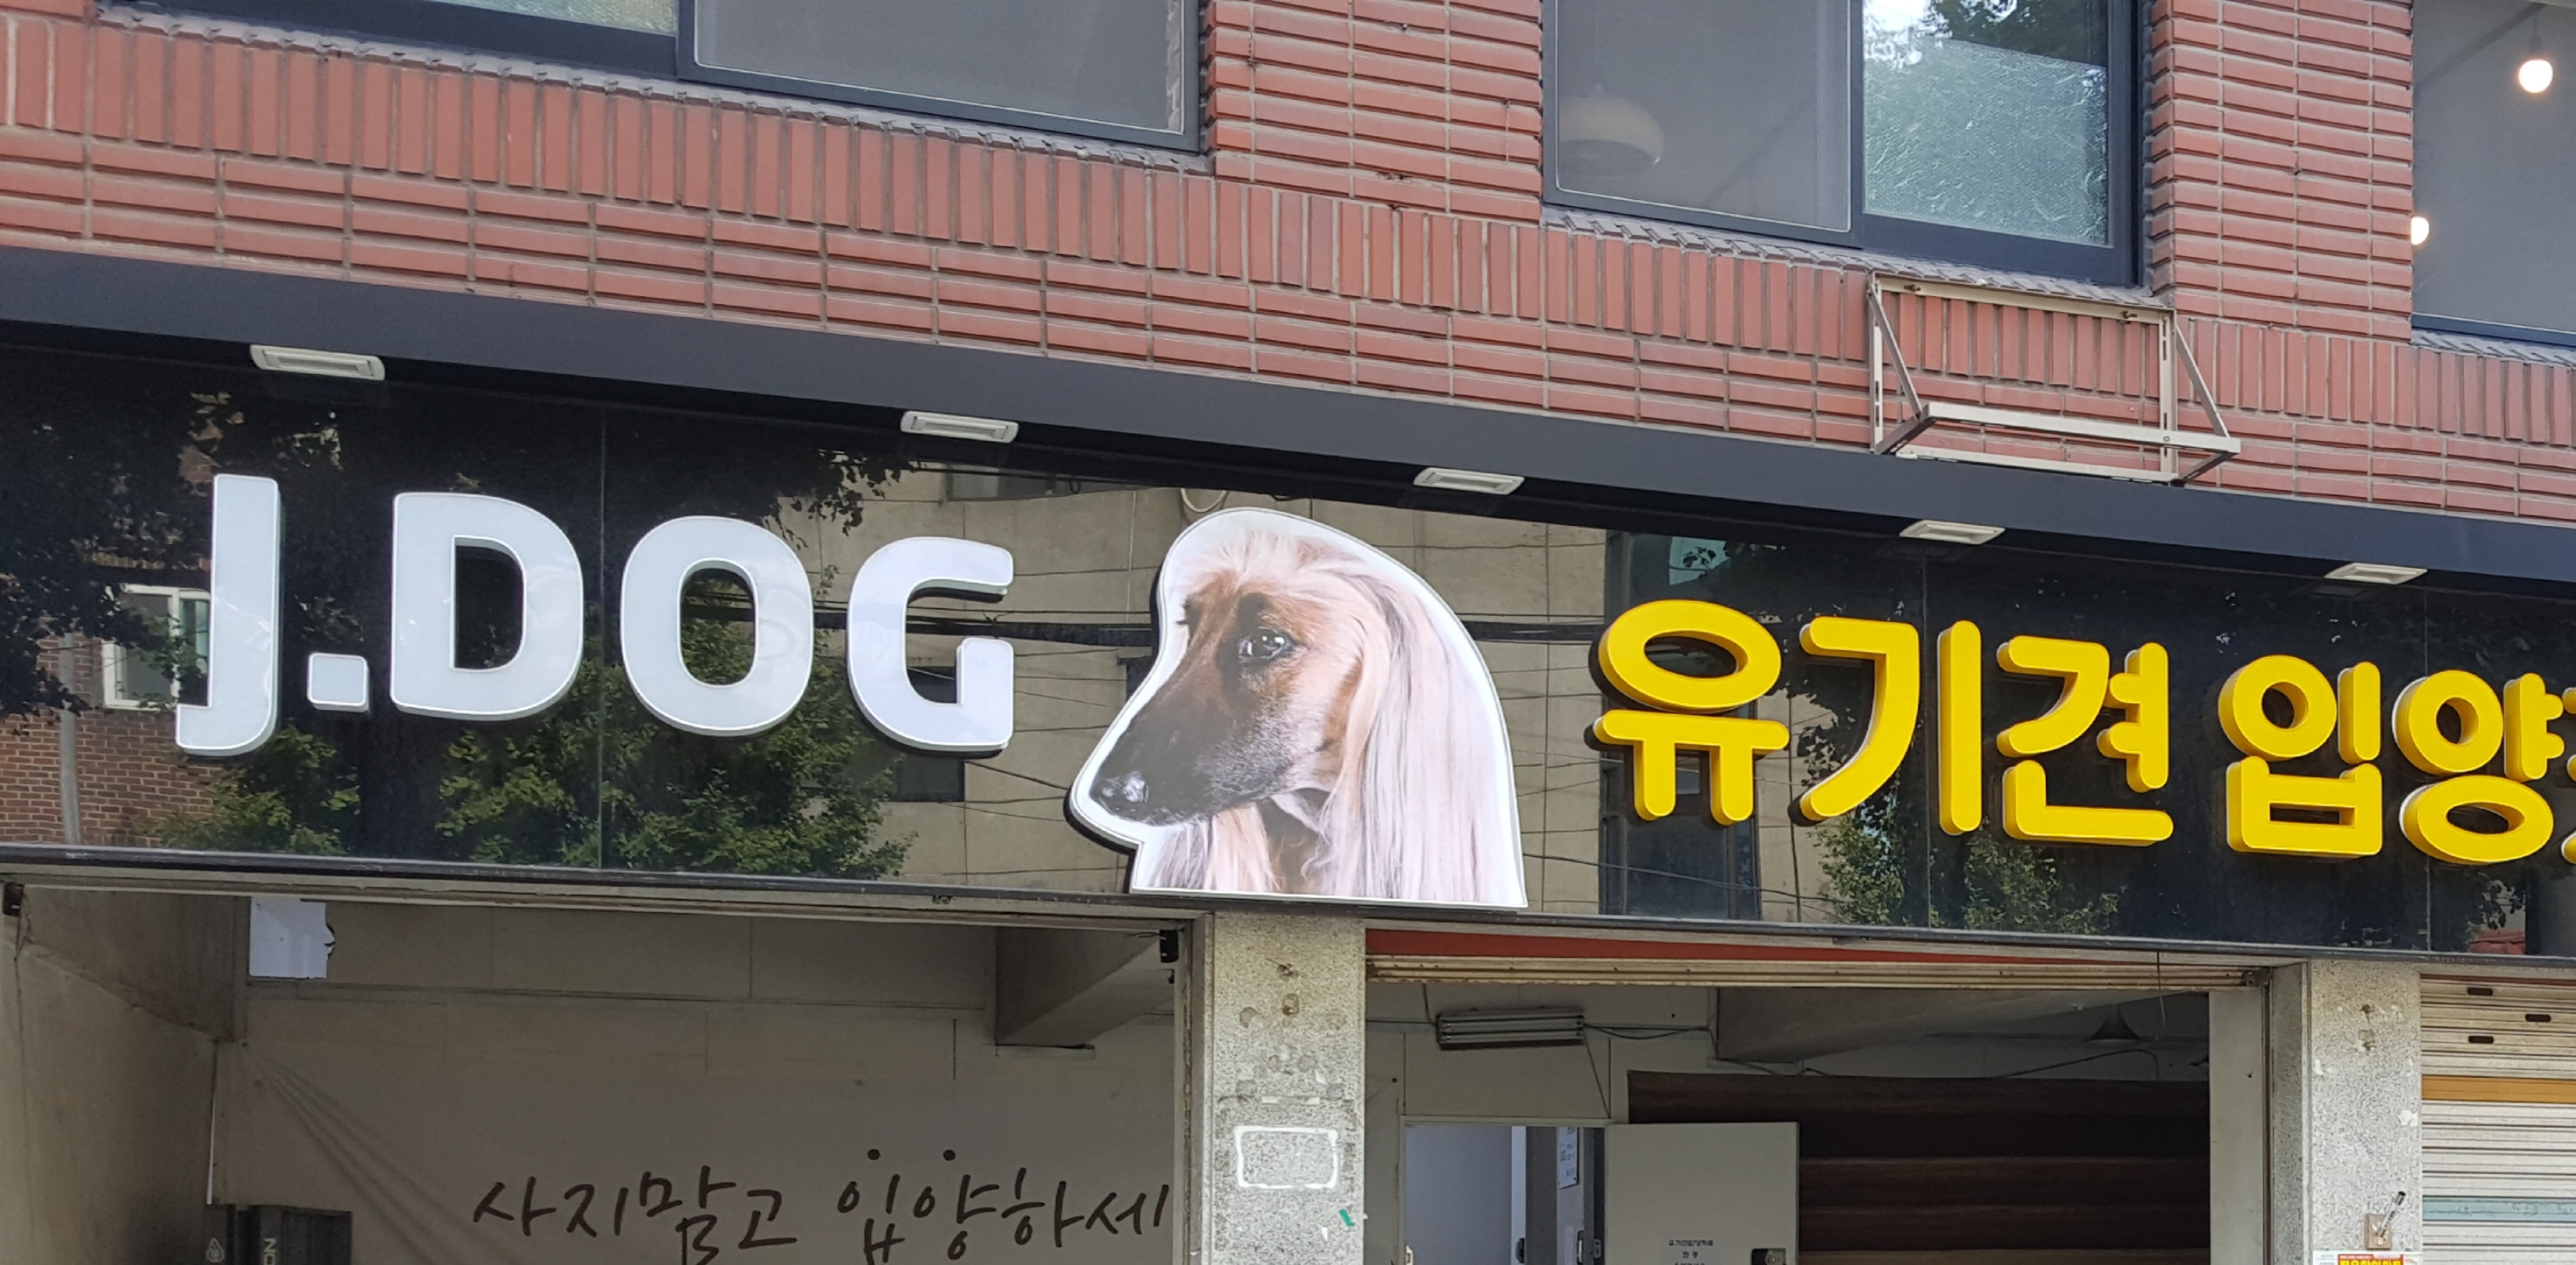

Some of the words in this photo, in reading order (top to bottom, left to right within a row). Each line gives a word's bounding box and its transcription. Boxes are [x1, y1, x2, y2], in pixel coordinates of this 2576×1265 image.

[175, 473, 1016, 755] J.DOG
[1592, 598, 2175, 847] 유기견
[2217, 653, 2576, 866] 입양
